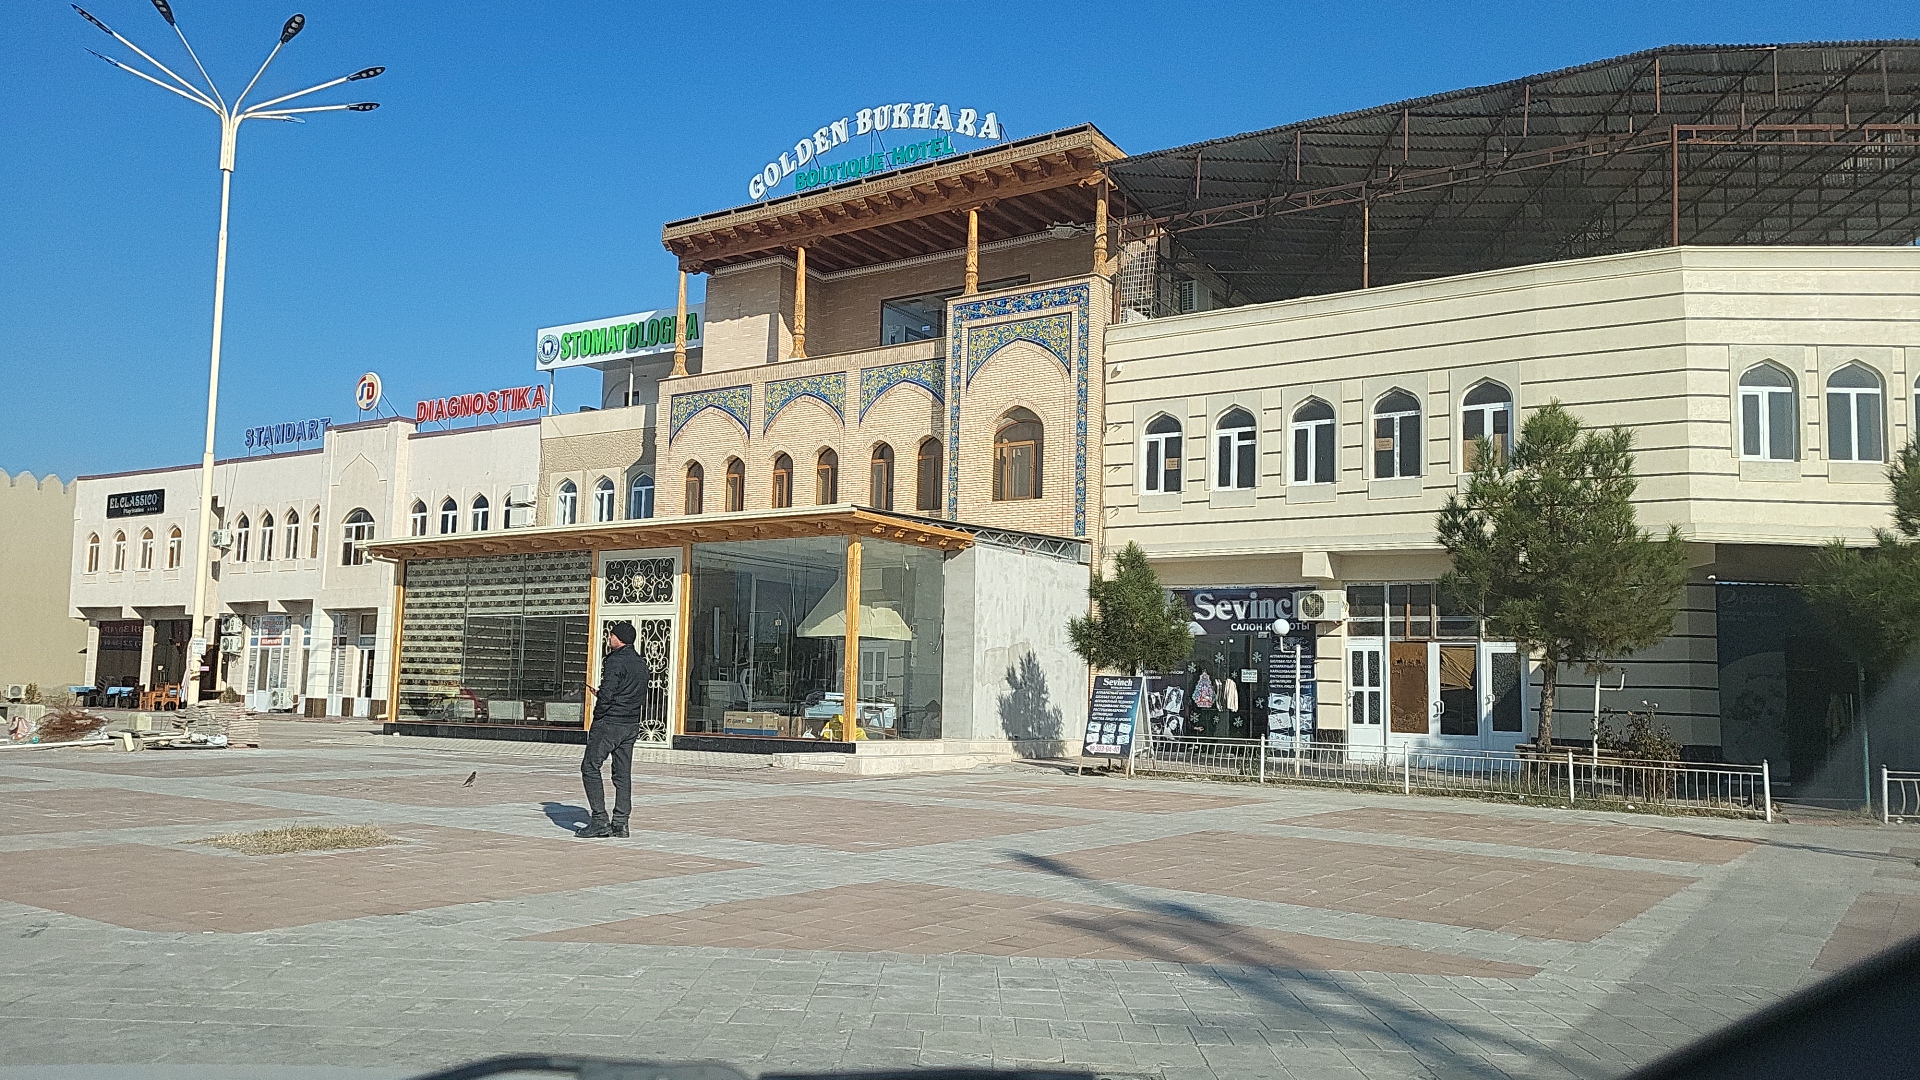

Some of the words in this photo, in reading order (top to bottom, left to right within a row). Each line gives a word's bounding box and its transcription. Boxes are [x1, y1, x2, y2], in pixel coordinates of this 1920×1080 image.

[749, 117, 850, 200] GOLDEN
[856, 103, 1000, 140] BUKHARA
[795, 151, 887, 191] BOUTIQUE
[892, 135, 956, 167] HOTEL
[560, 312, 699, 360] STOMATOLOGIA
[416, 384, 548, 424] DIAGNOSTIKA
[245, 417, 331, 448] STANDART
[110, 497, 120, 509] EL
[120, 493, 158, 508] CLASSICO
[1231, 623, 1263, 632] САЛОН
[1265, 623, 1310, 632] КОТЫ
[1103, 678, 1133, 687] Sevinch
